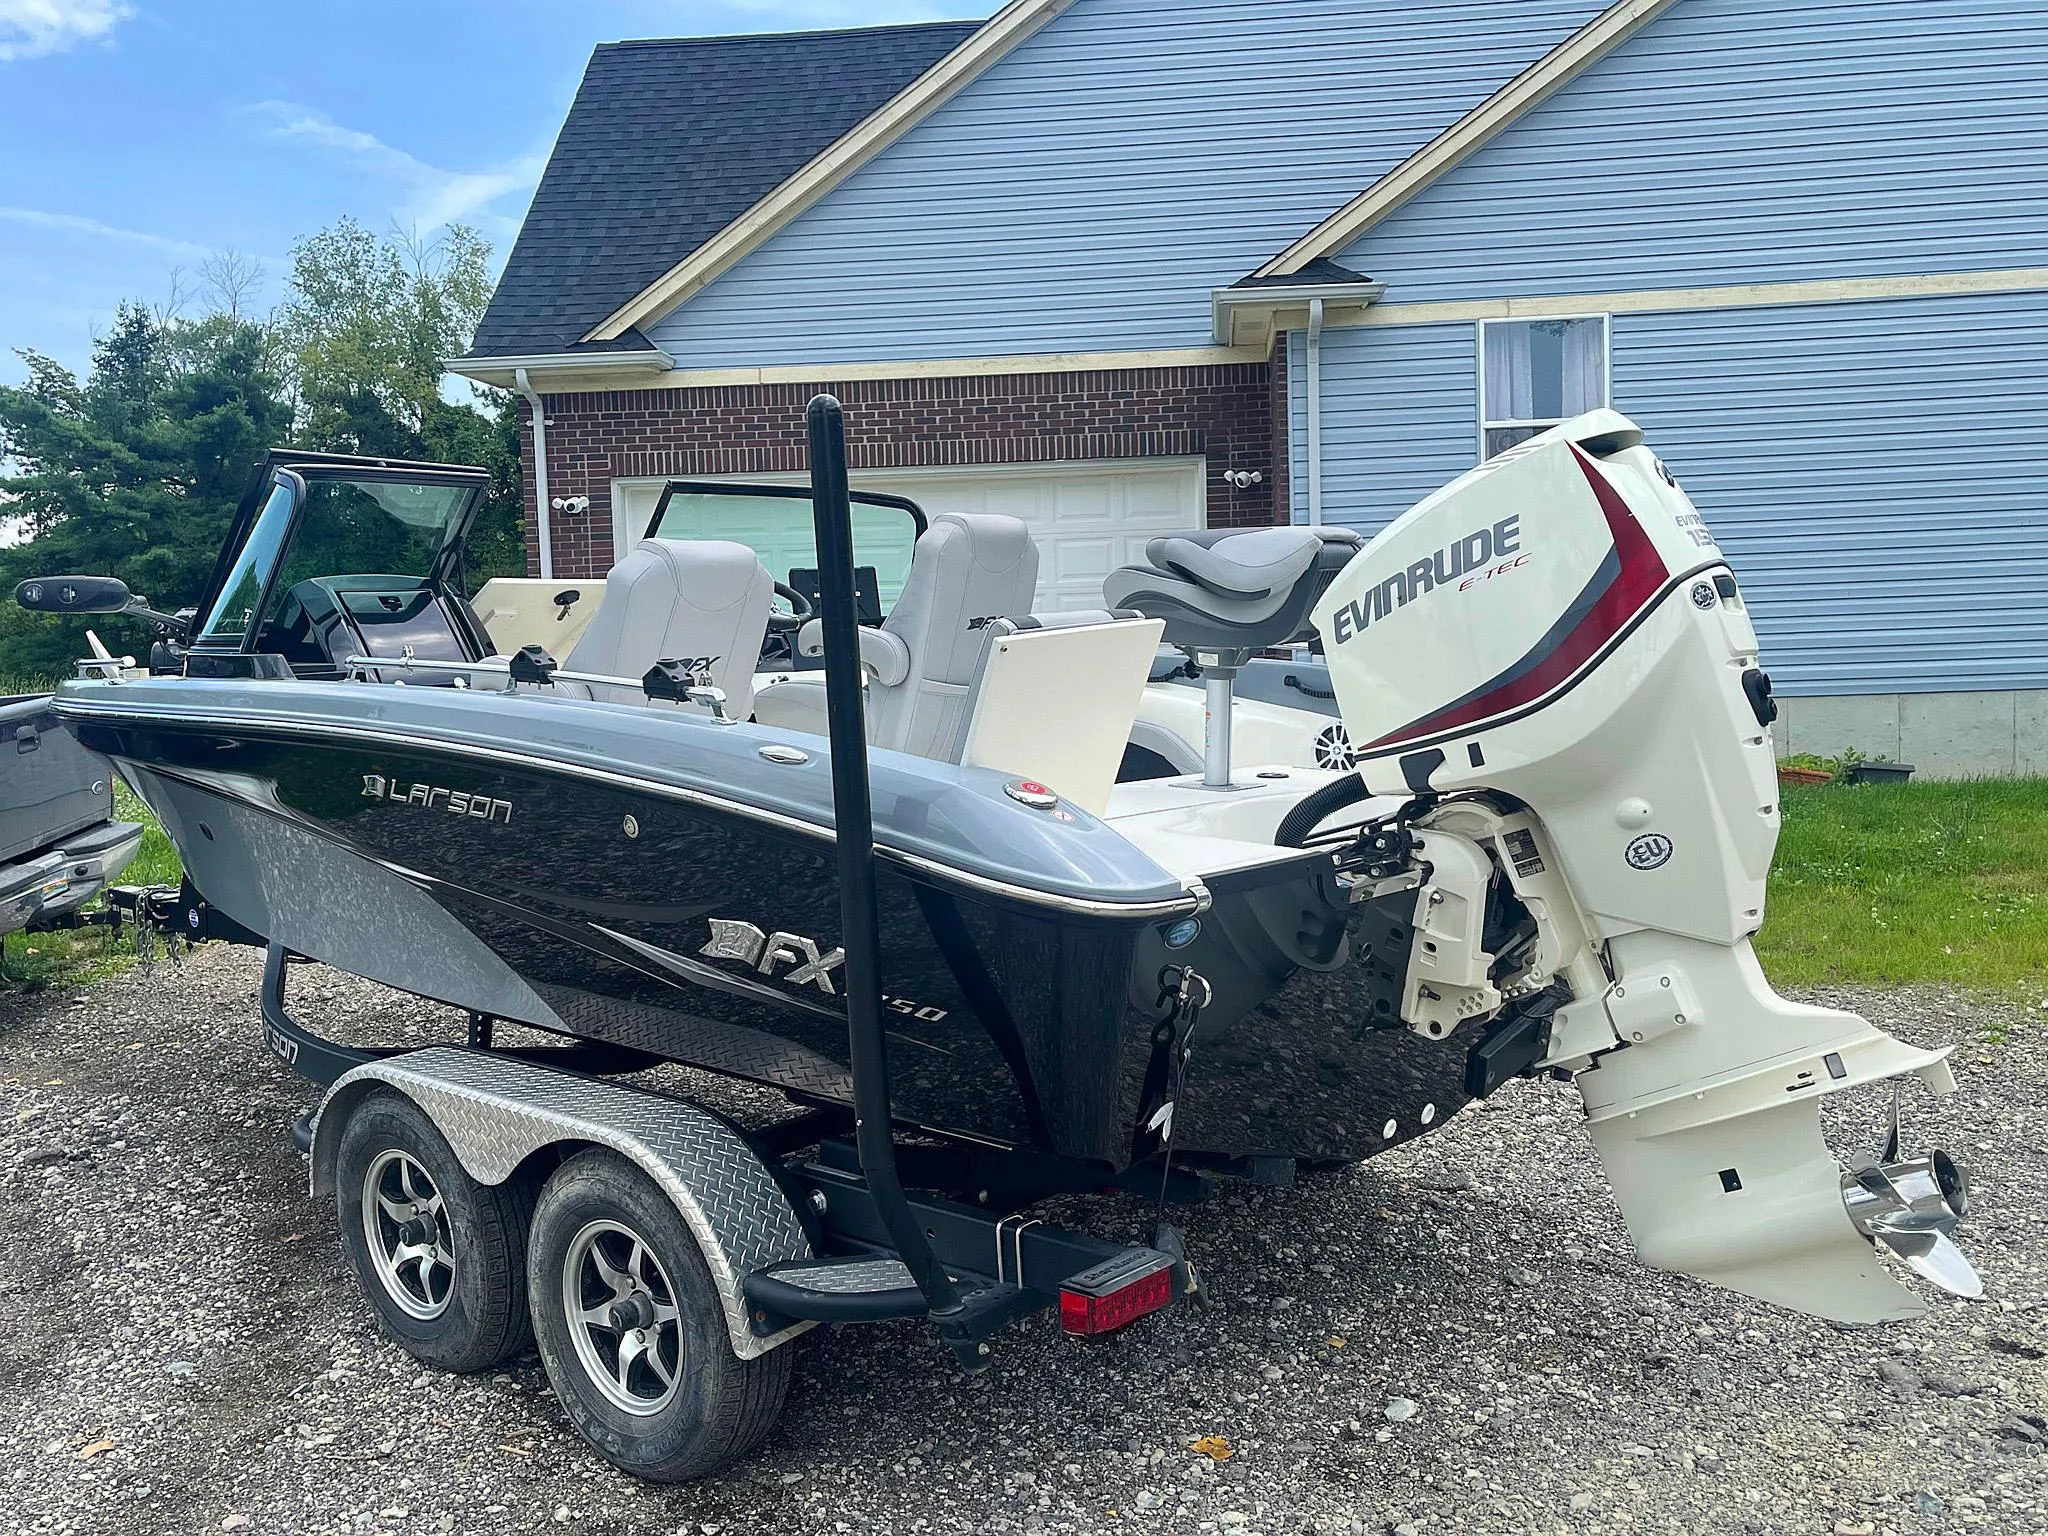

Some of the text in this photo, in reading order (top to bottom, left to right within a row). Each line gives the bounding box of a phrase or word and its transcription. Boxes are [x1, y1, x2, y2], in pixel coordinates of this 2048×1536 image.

[1687, 529, 1713, 547] 15
[1333, 513, 1520, 645] EVINRUDE
[1458, 552, 1532, 592] E-TEC
[263, 1017, 299, 1065] RSON
